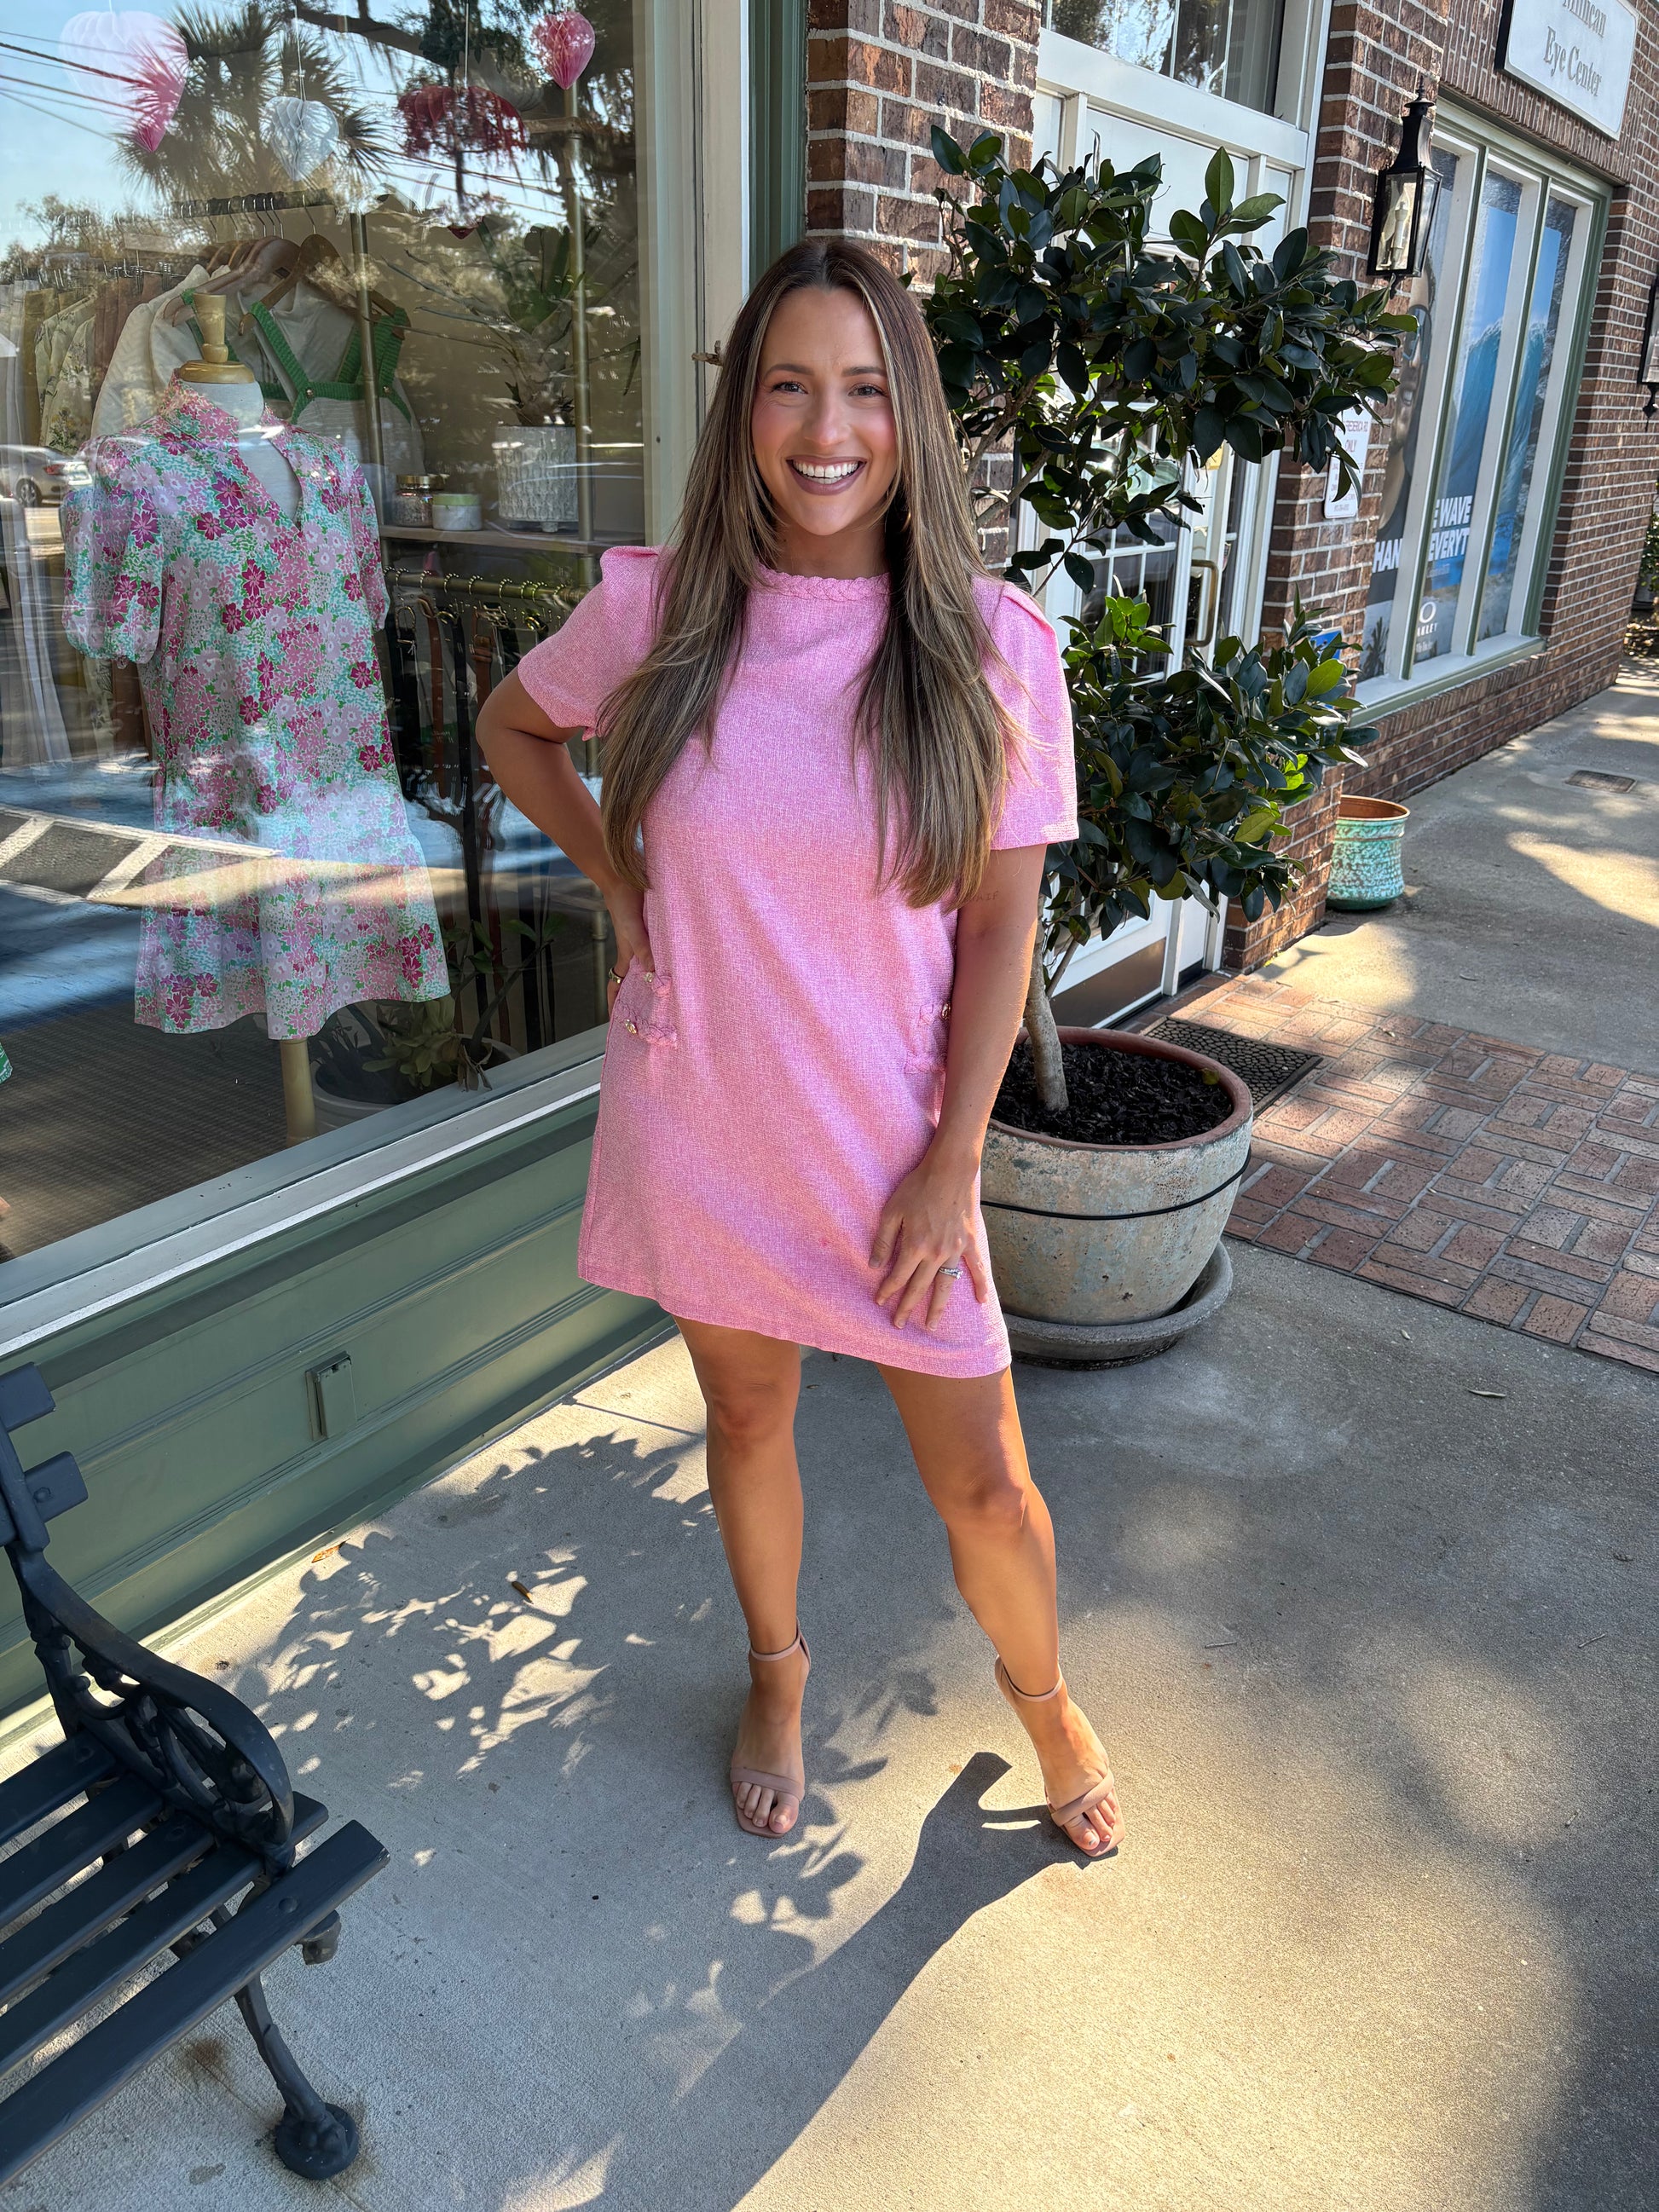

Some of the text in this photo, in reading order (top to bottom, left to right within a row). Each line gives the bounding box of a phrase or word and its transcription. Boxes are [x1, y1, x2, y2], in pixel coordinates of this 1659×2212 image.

[1562, 0, 1606, 38] illican
[1543, 26, 1603, 97] Eye Center
[1438, 495, 1473, 528] WAVE
